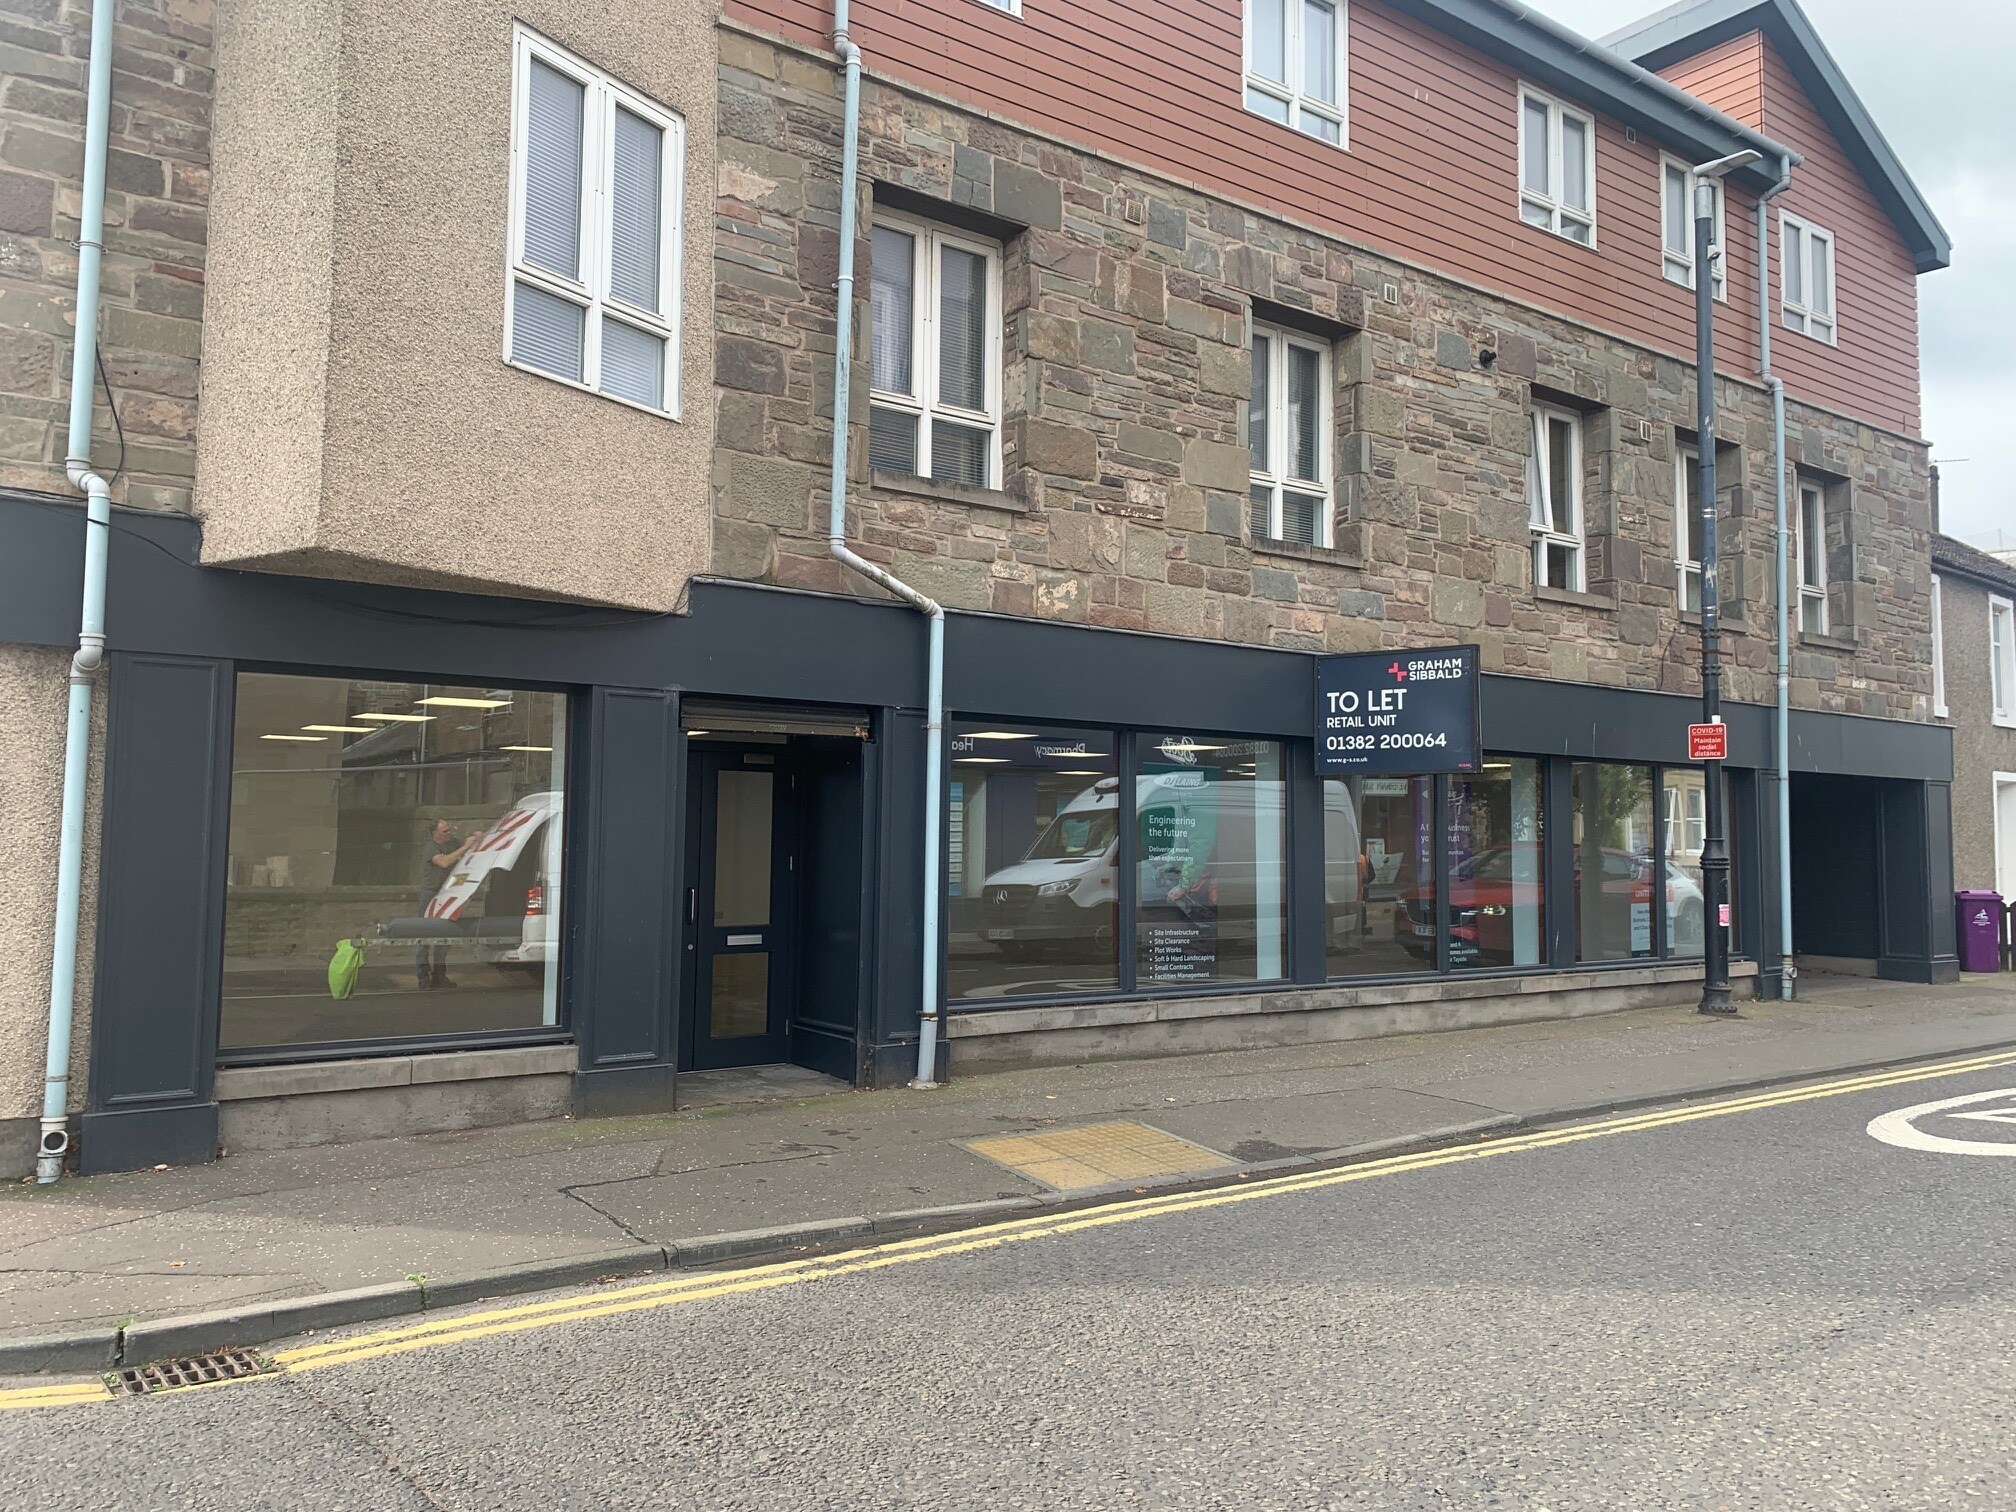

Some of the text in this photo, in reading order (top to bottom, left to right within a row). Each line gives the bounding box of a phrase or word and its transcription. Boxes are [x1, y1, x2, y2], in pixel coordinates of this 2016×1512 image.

[1408, 658, 1462, 670] GRAHAM
[1409, 669, 1462, 680] SIBBALD
[1327, 689, 1407, 712] TO LET
[1327, 714, 1397, 728] RETAIL UNIT
[1327, 733, 1446, 750] 01382 200064
[1327, 756, 1368, 764] www.g-s.co.uk
[1176, 777, 1201, 786] LAING
[1149, 815, 1196, 828] Engineering
[1149, 828, 1188, 837] the future
[1184, 954, 1215, 962] Landscaping
